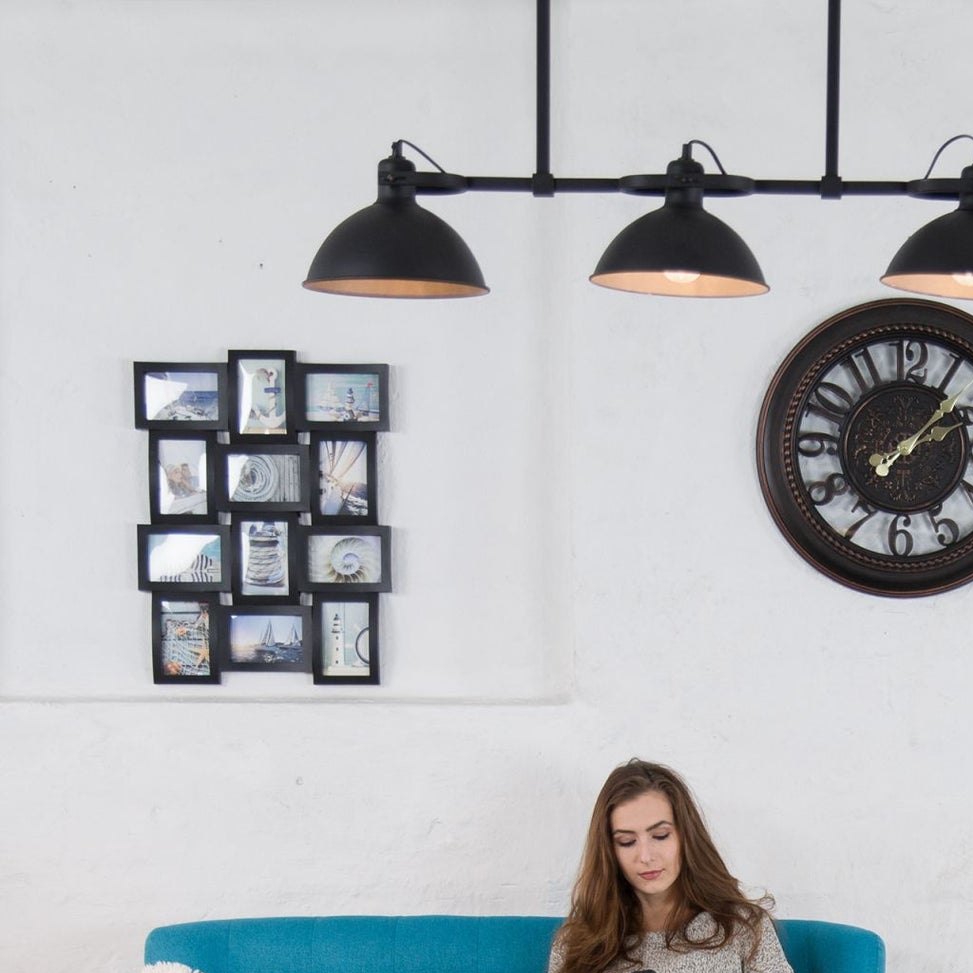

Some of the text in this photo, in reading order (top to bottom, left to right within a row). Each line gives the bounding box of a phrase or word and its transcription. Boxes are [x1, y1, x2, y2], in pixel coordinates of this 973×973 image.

[839, 348, 879, 391] 11
[890, 340, 928, 385] 12
[932, 354, 962, 390] 1
[806, 382, 853, 424] 10
[798, 432, 839, 458] 9
[808, 473, 848, 506] 8
[844, 500, 879, 540] 7
[888, 513, 914, 557] 6
[929, 504, 960, 547] 5
